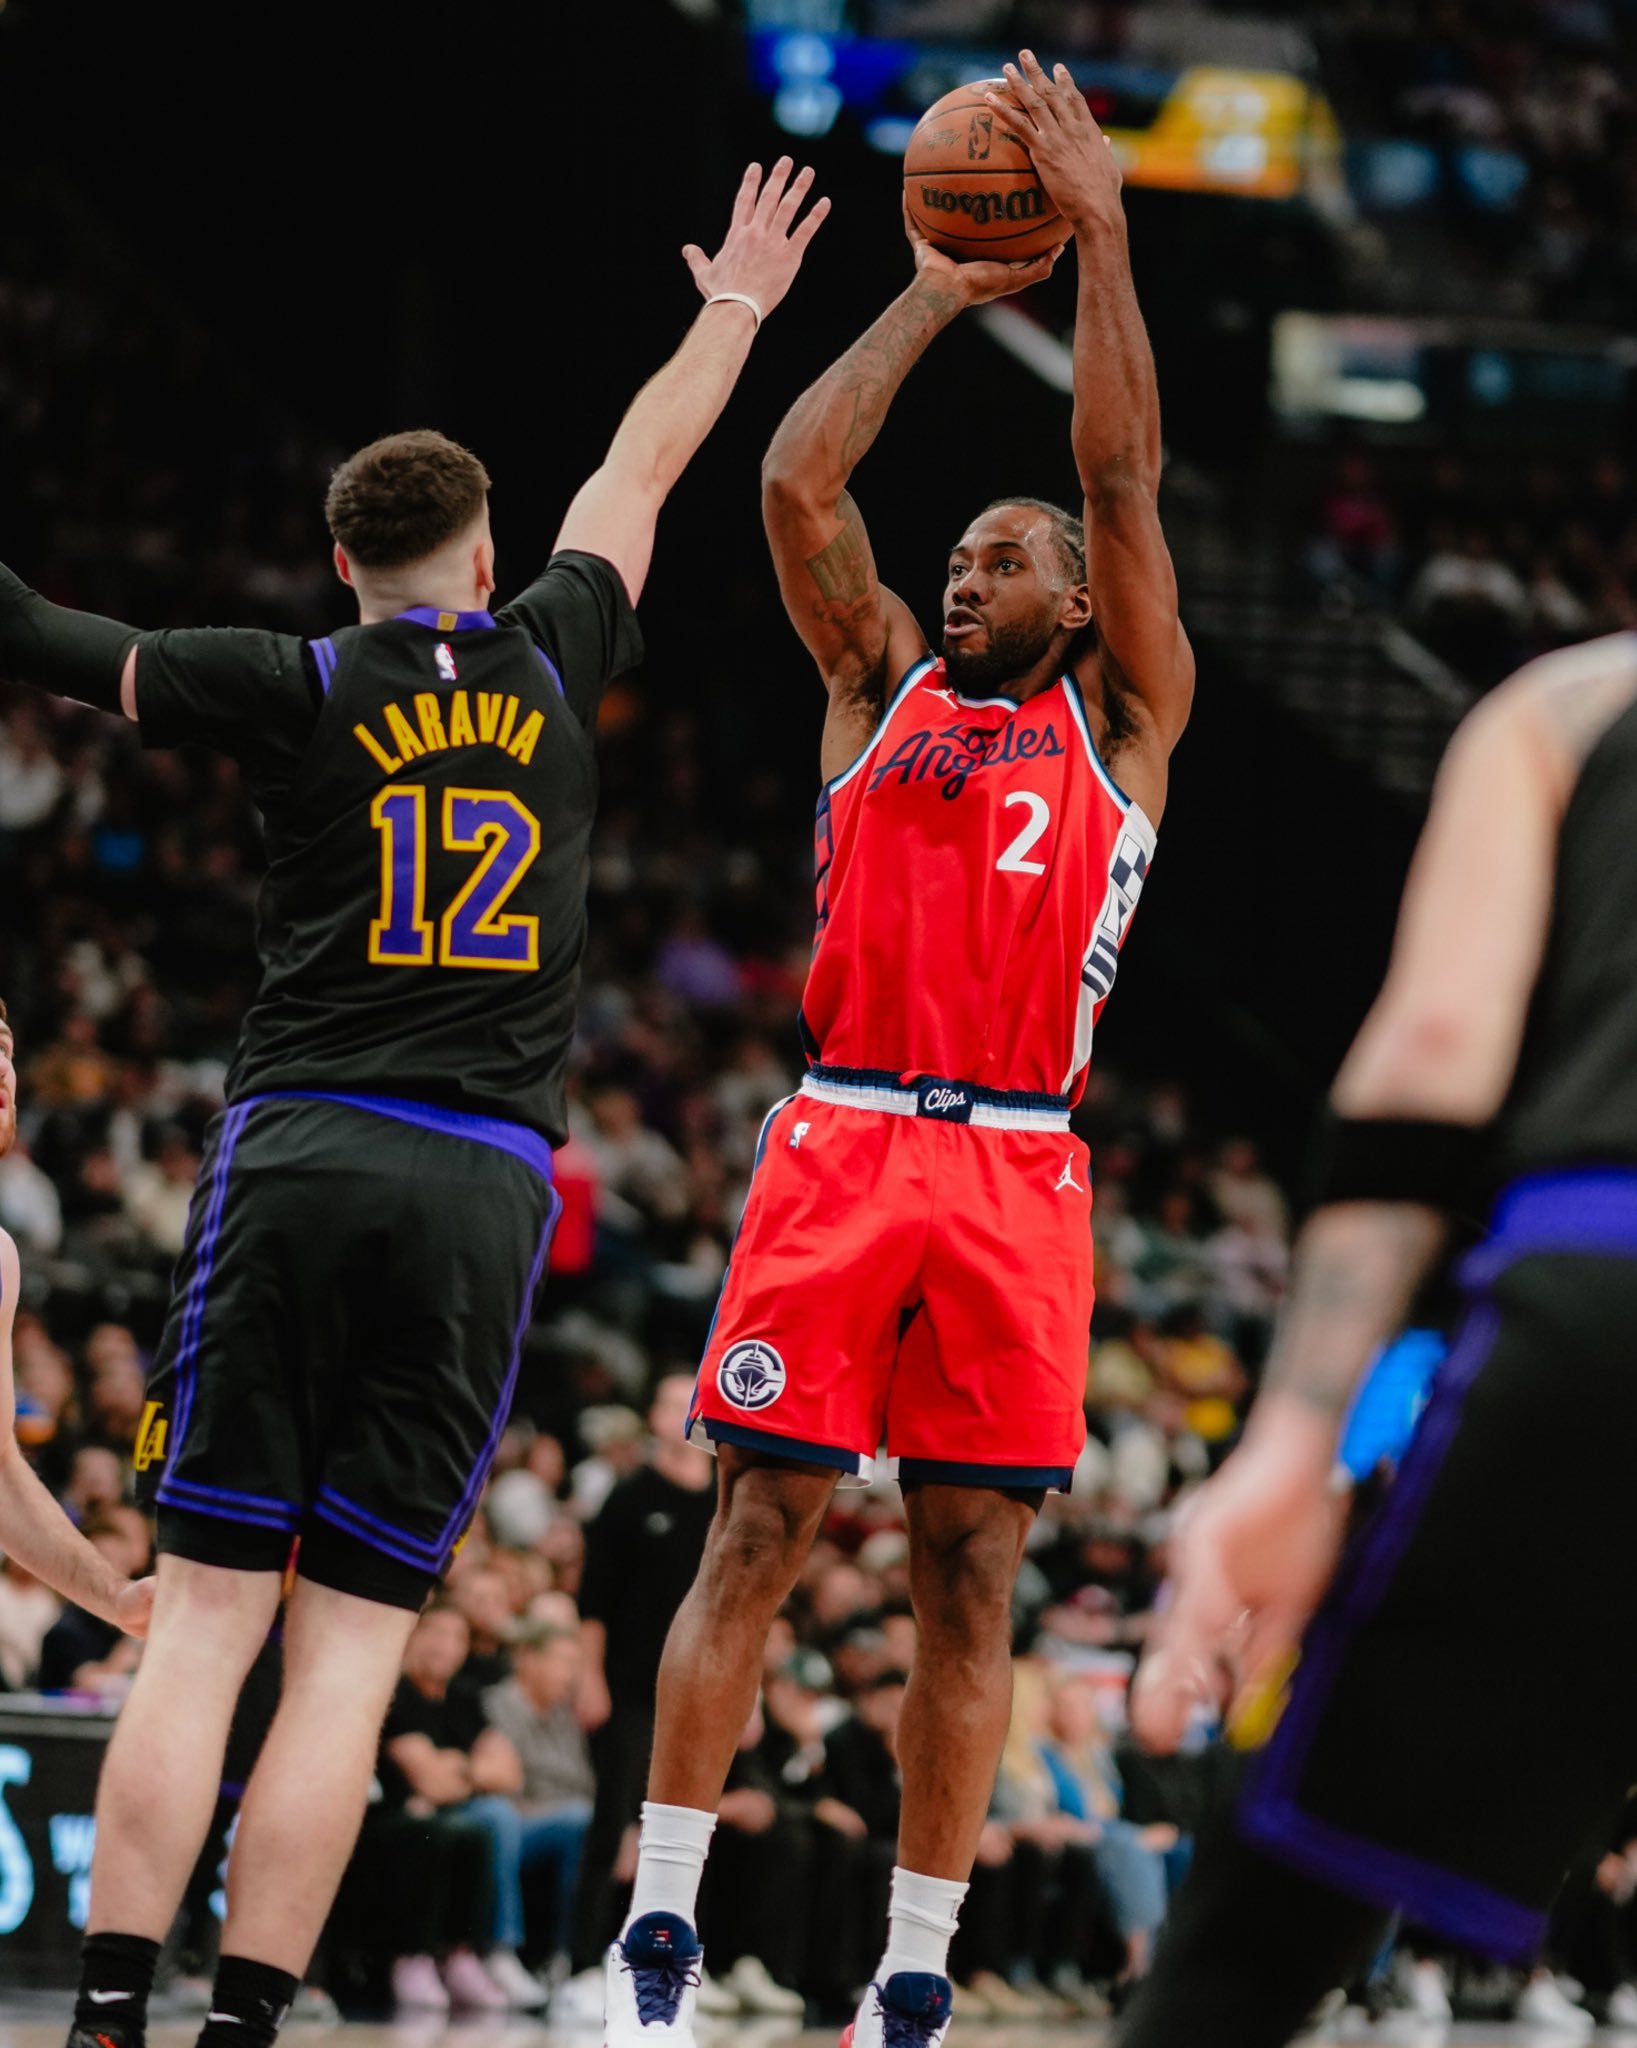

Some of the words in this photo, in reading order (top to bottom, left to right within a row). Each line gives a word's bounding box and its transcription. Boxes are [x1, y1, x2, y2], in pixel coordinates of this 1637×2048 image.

[920, 184, 1047, 225] Wilson
[353, 690, 545, 775] LARAVIA
[867, 720, 1066, 801] Angeles
[996, 791, 1050, 875] 2
[368, 785, 541, 970] 12
[925, 1088, 967, 1112] Clips
